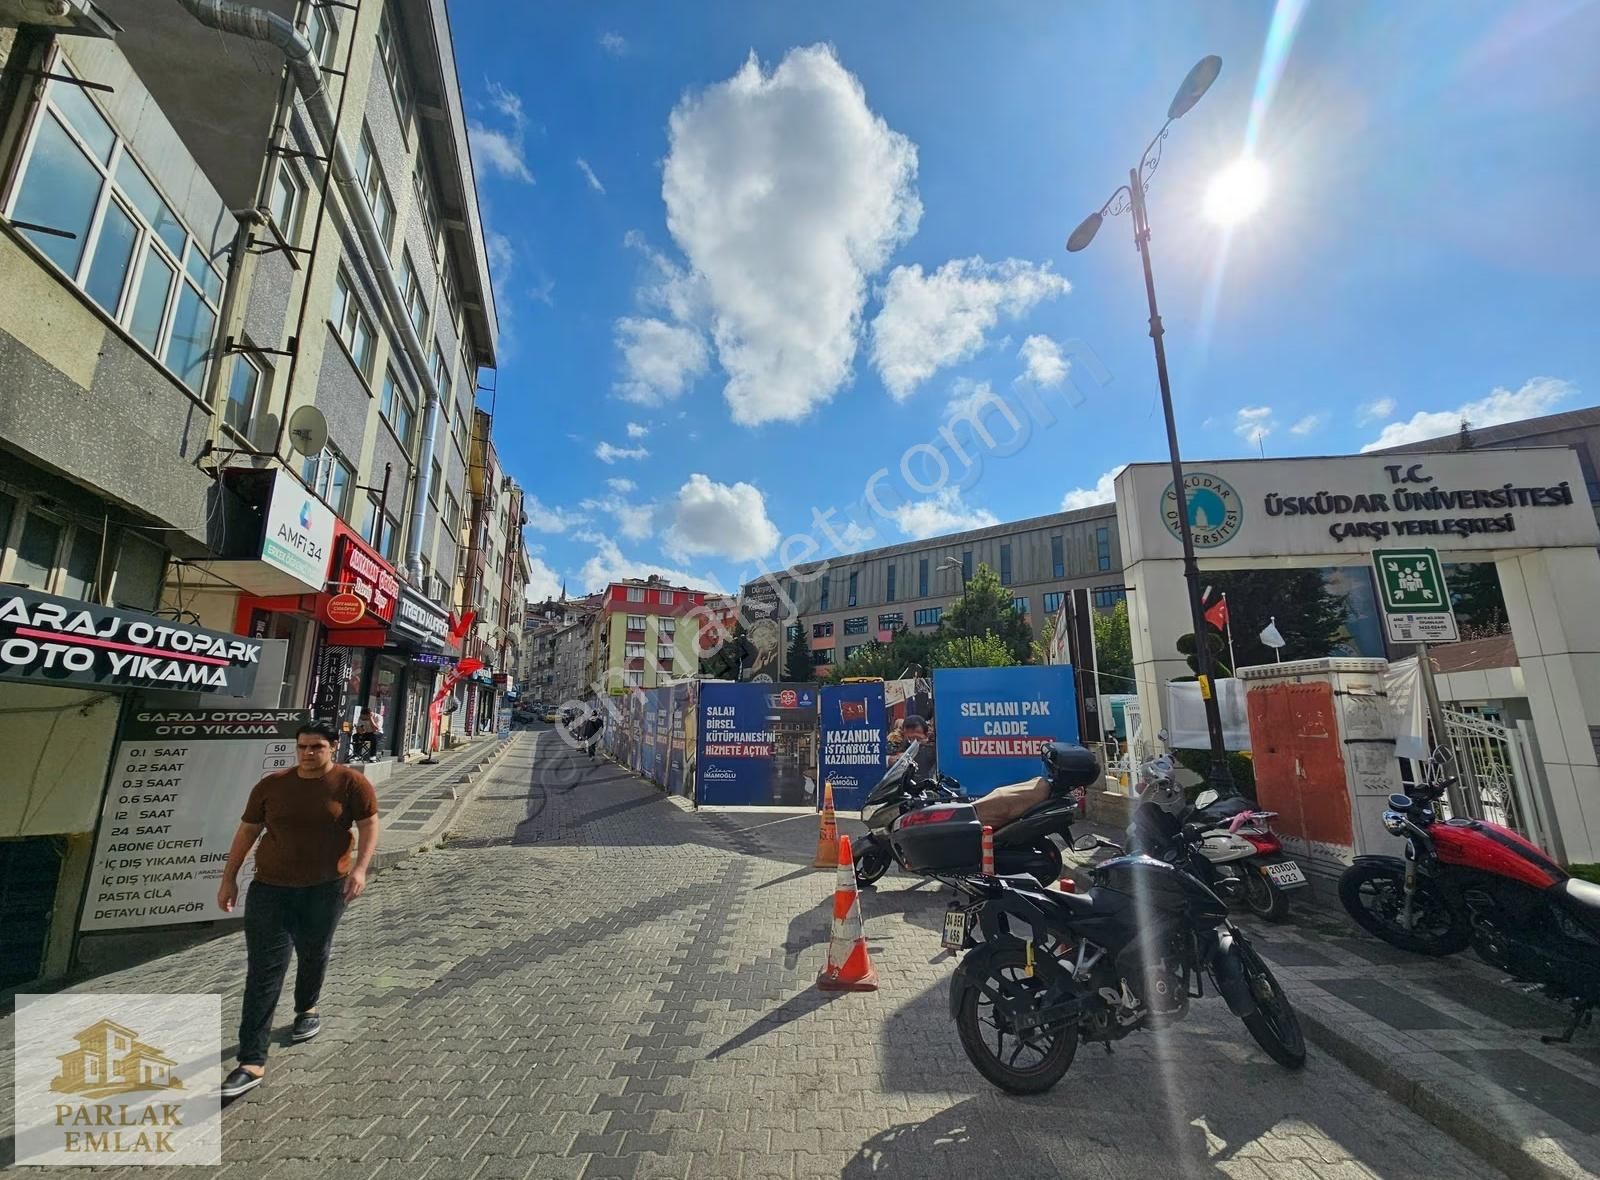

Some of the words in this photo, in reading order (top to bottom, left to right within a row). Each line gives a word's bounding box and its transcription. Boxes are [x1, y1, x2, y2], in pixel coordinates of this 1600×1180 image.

[1384, 464, 1433, 484] T.C.
[1167, 476, 1230, 501] ÜKÜDAR
[1264, 491, 1390, 517] ÜSKÜDAR
[1392, 481, 1574, 512] ÜNİVERSİTESİ
[1166, 510, 1238, 544] ÜNERSİTESİ
[1329, 520, 1390, 543] ÇARŞI
[1391, 513, 1516, 539] YERLEŞKESİ
[128, 621, 261, 663] OTOPARK
[0, 638, 95, 672] OTO
[107, 651, 228, 687] YIKAMA
[325, 657, 337, 702] TREND
[706, 706, 735, 716] SALAH
[960, 702, 1019, 716] SELMANI
[1021, 701, 1051, 715] PAK
[137, 712, 207, 722] GARAJ
[211, 712, 300, 722] OTOPARK
[706, 717, 736, 729] BİRSEL
[155, 725, 197, 735] OTO
[202, 725, 279, 735] YIKAMA
[983, 721, 1029, 736] CADDE
[706, 729, 776, 743] KÜTÜPHANESİ'Nİ
[826, 729, 881, 744] KAZANDIK
[154, 748, 189, 757] SAAT
[705, 745, 742, 756] HİZMETE
[743, 745, 769, 758] AÇTIK
[126, 764, 148, 773] 0.2
[150, 763, 184, 772] SAAT
[273, 759, 286, 767] 80
[825, 754, 881, 765] KAZANDIRDIK
[122, 779, 143, 789] 0.3
[146, 778, 182, 788] SAAT
[119, 795, 141, 804] 0.6
[143, 794, 178, 803] SAAT
[114, 811, 128, 820] 12
[139, 809, 175, 819] SAAT
[111, 827, 129, 836] 24
[136, 825, 172, 835] SAAT
[107, 842, 154, 853] ABONE
[156, 837, 204, 850] ÜCRETİ
[119, 858, 142, 869] DIŞ
[145, 855, 196, 867] YIKAMA
[116, 874, 139, 886] DIŞ
[142, 871, 193, 883] YIKAMA
[1280, 872, 1298, 883] 023
[98, 892, 140, 902] PASTA
[144, 888, 173, 899] CİLA
[94, 907, 147, 919] DETAYLI
[149, 902, 205, 915] KUAFÖR
